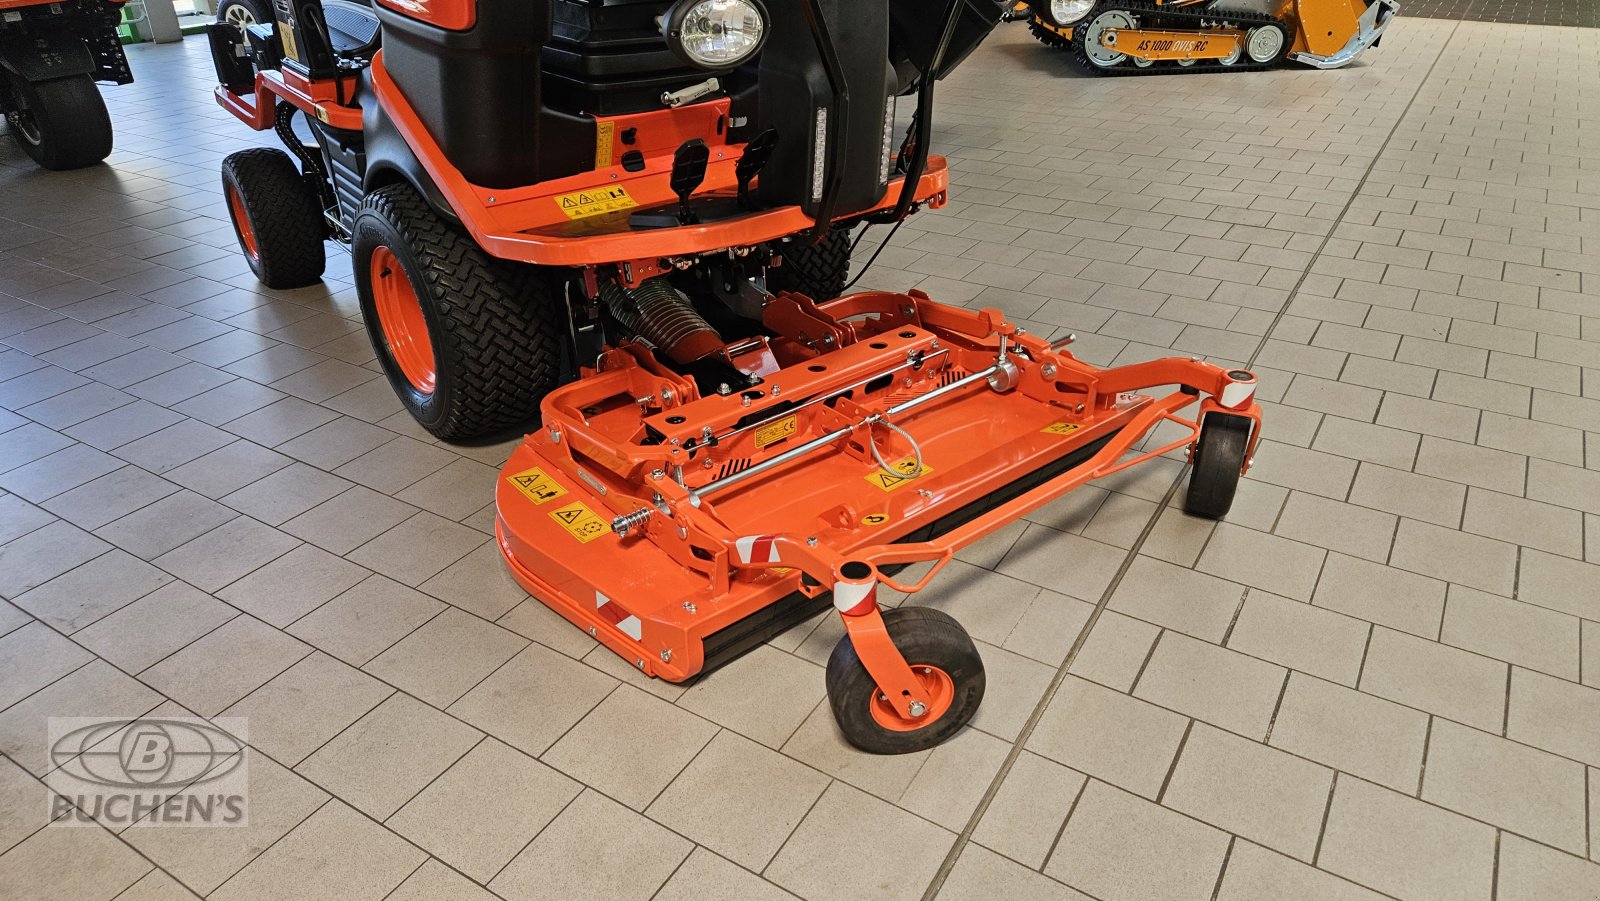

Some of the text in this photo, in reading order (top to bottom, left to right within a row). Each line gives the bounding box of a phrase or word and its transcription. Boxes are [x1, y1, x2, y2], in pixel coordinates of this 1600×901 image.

[1136, 40, 1209, 52] AS 1000 OVIS RC
